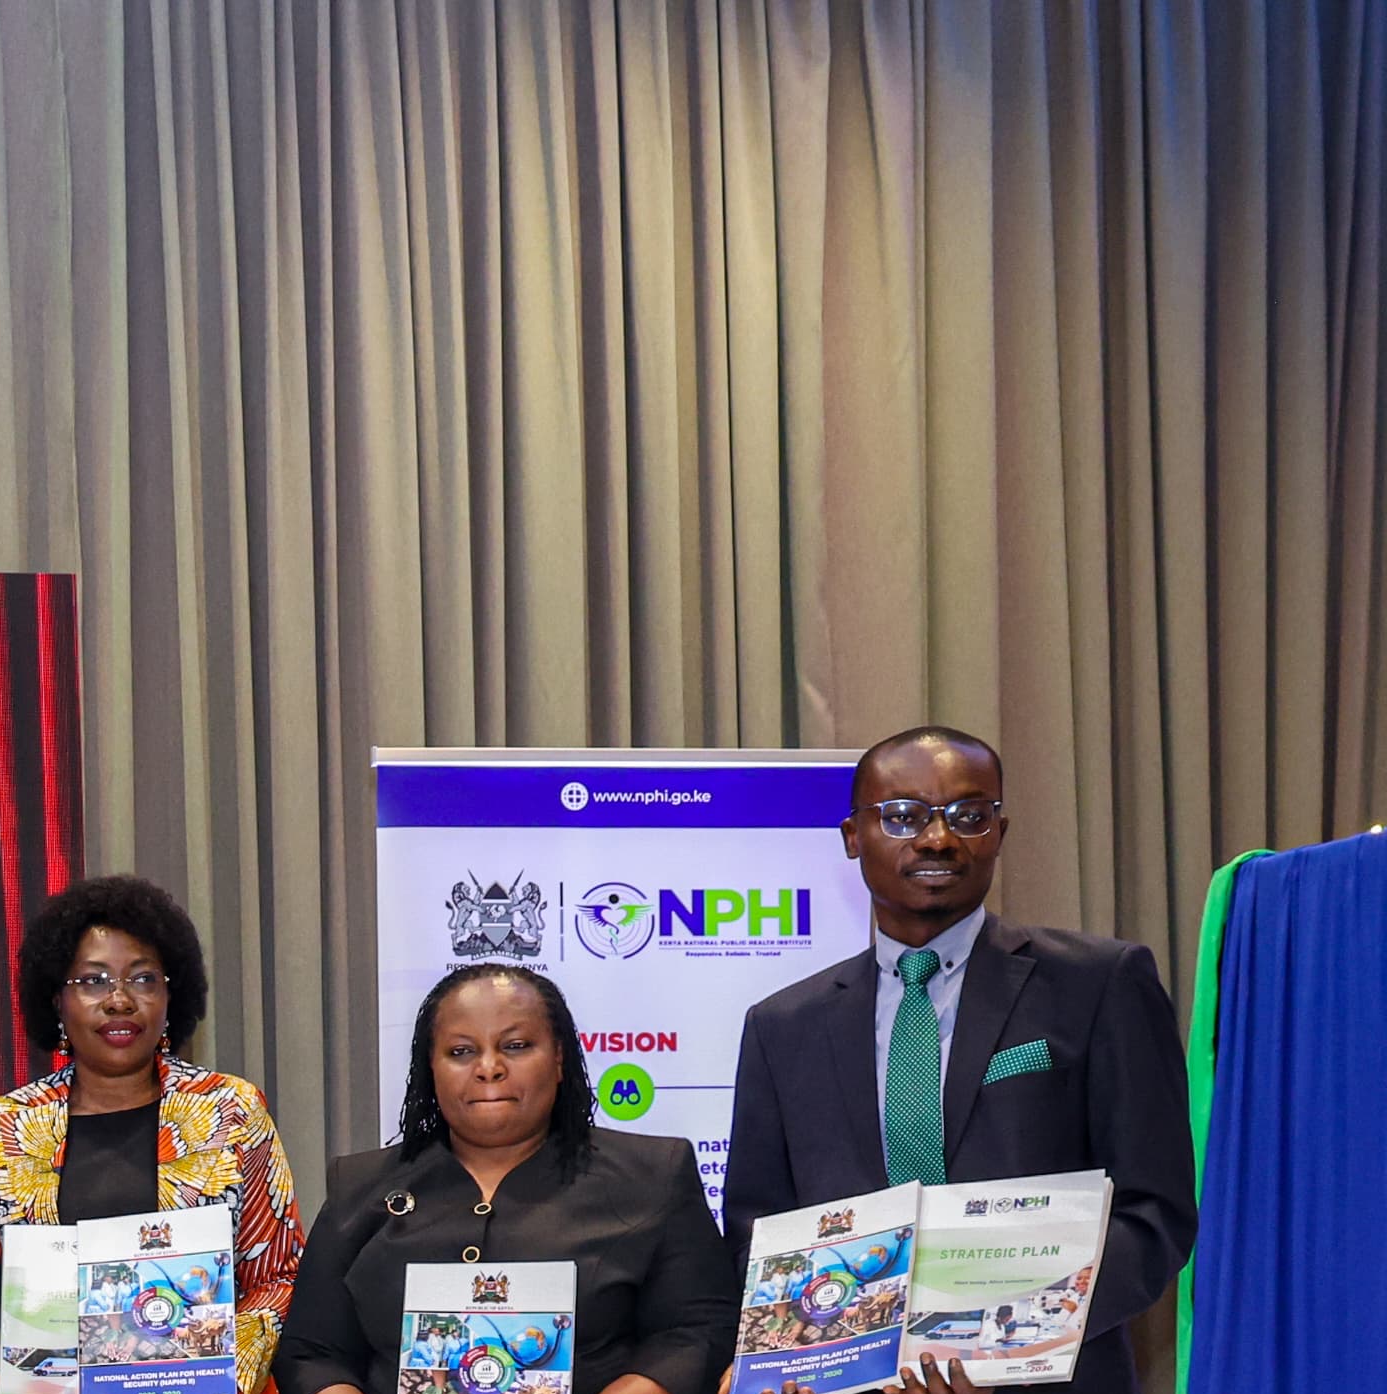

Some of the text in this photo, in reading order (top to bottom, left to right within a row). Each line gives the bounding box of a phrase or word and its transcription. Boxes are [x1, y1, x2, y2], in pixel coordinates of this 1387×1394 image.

[592, 788, 712, 806] www.nphi.go.ke
[658, 888, 811, 937] NPHI
[579, 1031, 677, 1053] VISION
[1014, 1195, 1050, 1208] NPHI
[940, 1245, 1060, 1260] STRATEGIC PLAN
[749, 1338, 891, 1371] NATIONAL ACTION PLAN FOR HEALTH
[94, 1368, 225, 1383] NATIONAL ACTION PLAN FOR HEALTH
[781, 1362, 820, 1374] SECURITY
[123, 1381, 159, 1389] SECURITY
